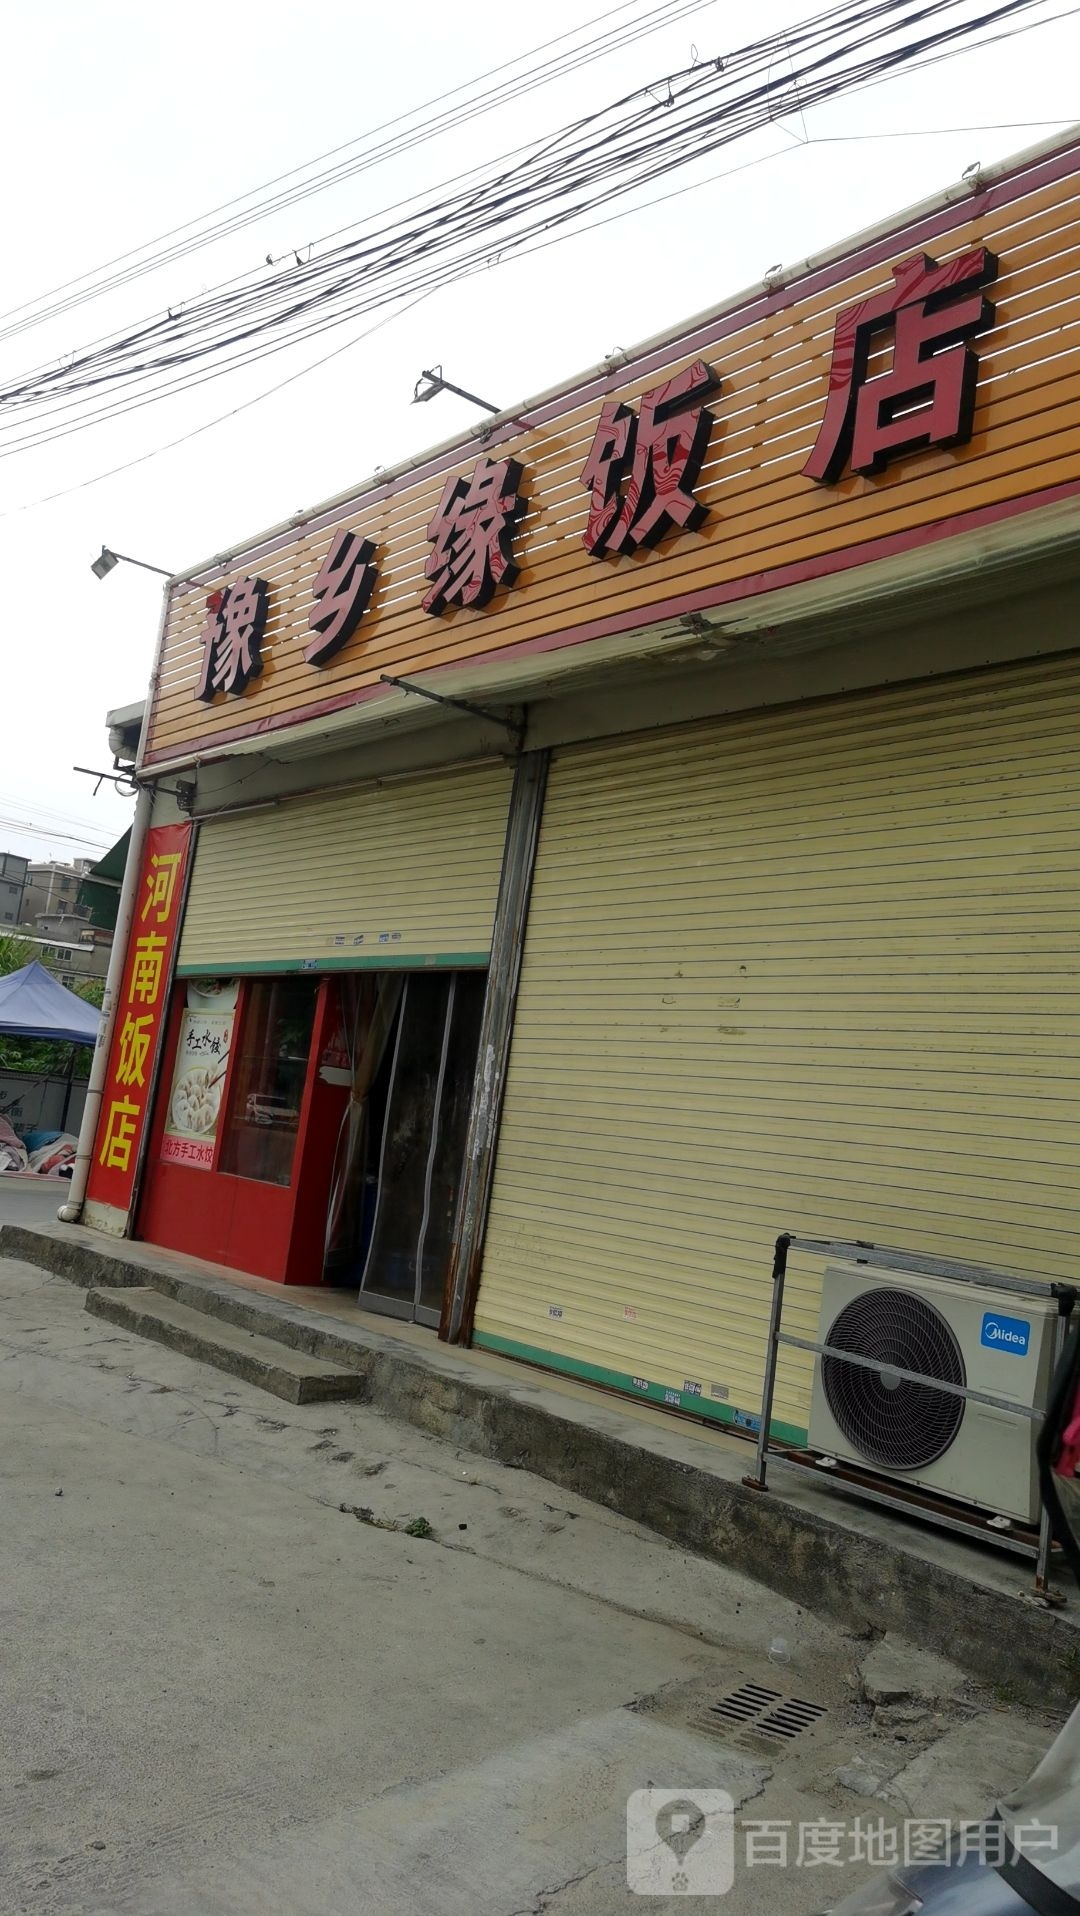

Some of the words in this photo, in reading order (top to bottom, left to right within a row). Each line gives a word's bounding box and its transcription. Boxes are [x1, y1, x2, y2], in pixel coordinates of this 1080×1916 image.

[193, 246, 998, 704] 豫乡缘饭店
[100, 853, 181, 1172] 河南饭店
[187, 1029, 221, 1055] 手工水饺
[164, 1139, 213, 1163] 北方手工水饺
[985, 1322, 1026, 1345] Midea
